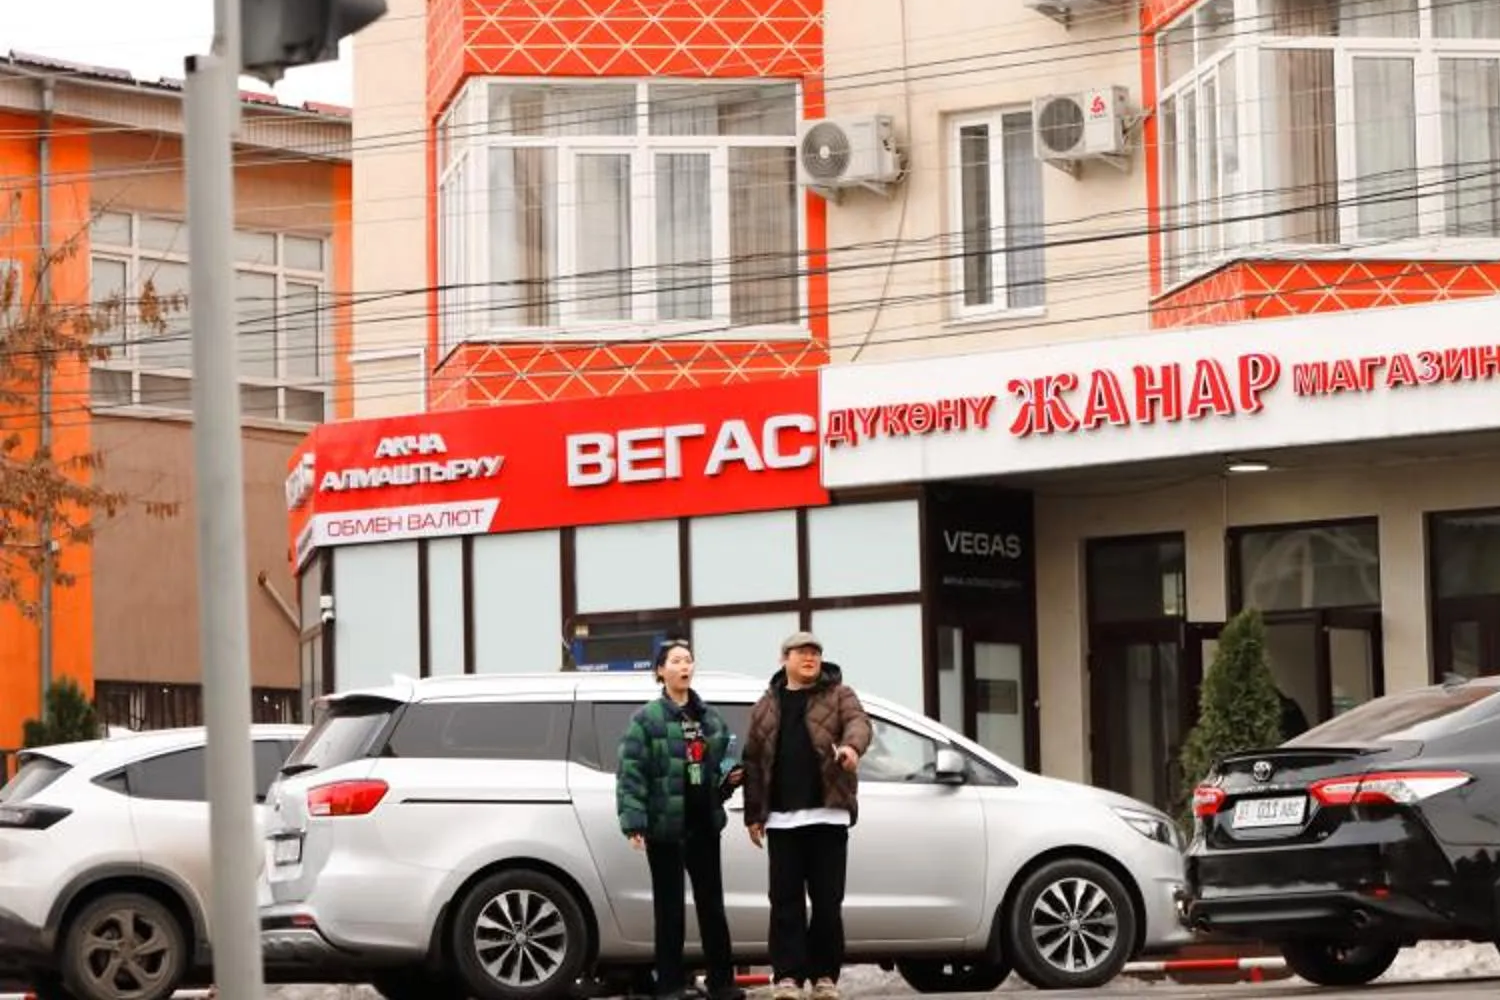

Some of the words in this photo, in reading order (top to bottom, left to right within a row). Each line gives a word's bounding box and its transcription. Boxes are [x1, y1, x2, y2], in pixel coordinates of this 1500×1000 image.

[1007, 352, 1281, 437] ЖАНАР
[374, 431, 448, 459] АКЧА
[565, 413, 817, 488] ВЕГАС
[319, 455, 505, 492] АЛМАШТЫРУУ
[326, 514, 401, 538] ОБМЕН
[407, 507, 485, 533] ВАЛЮТ
[943, 530, 1022, 558] VEGAS
